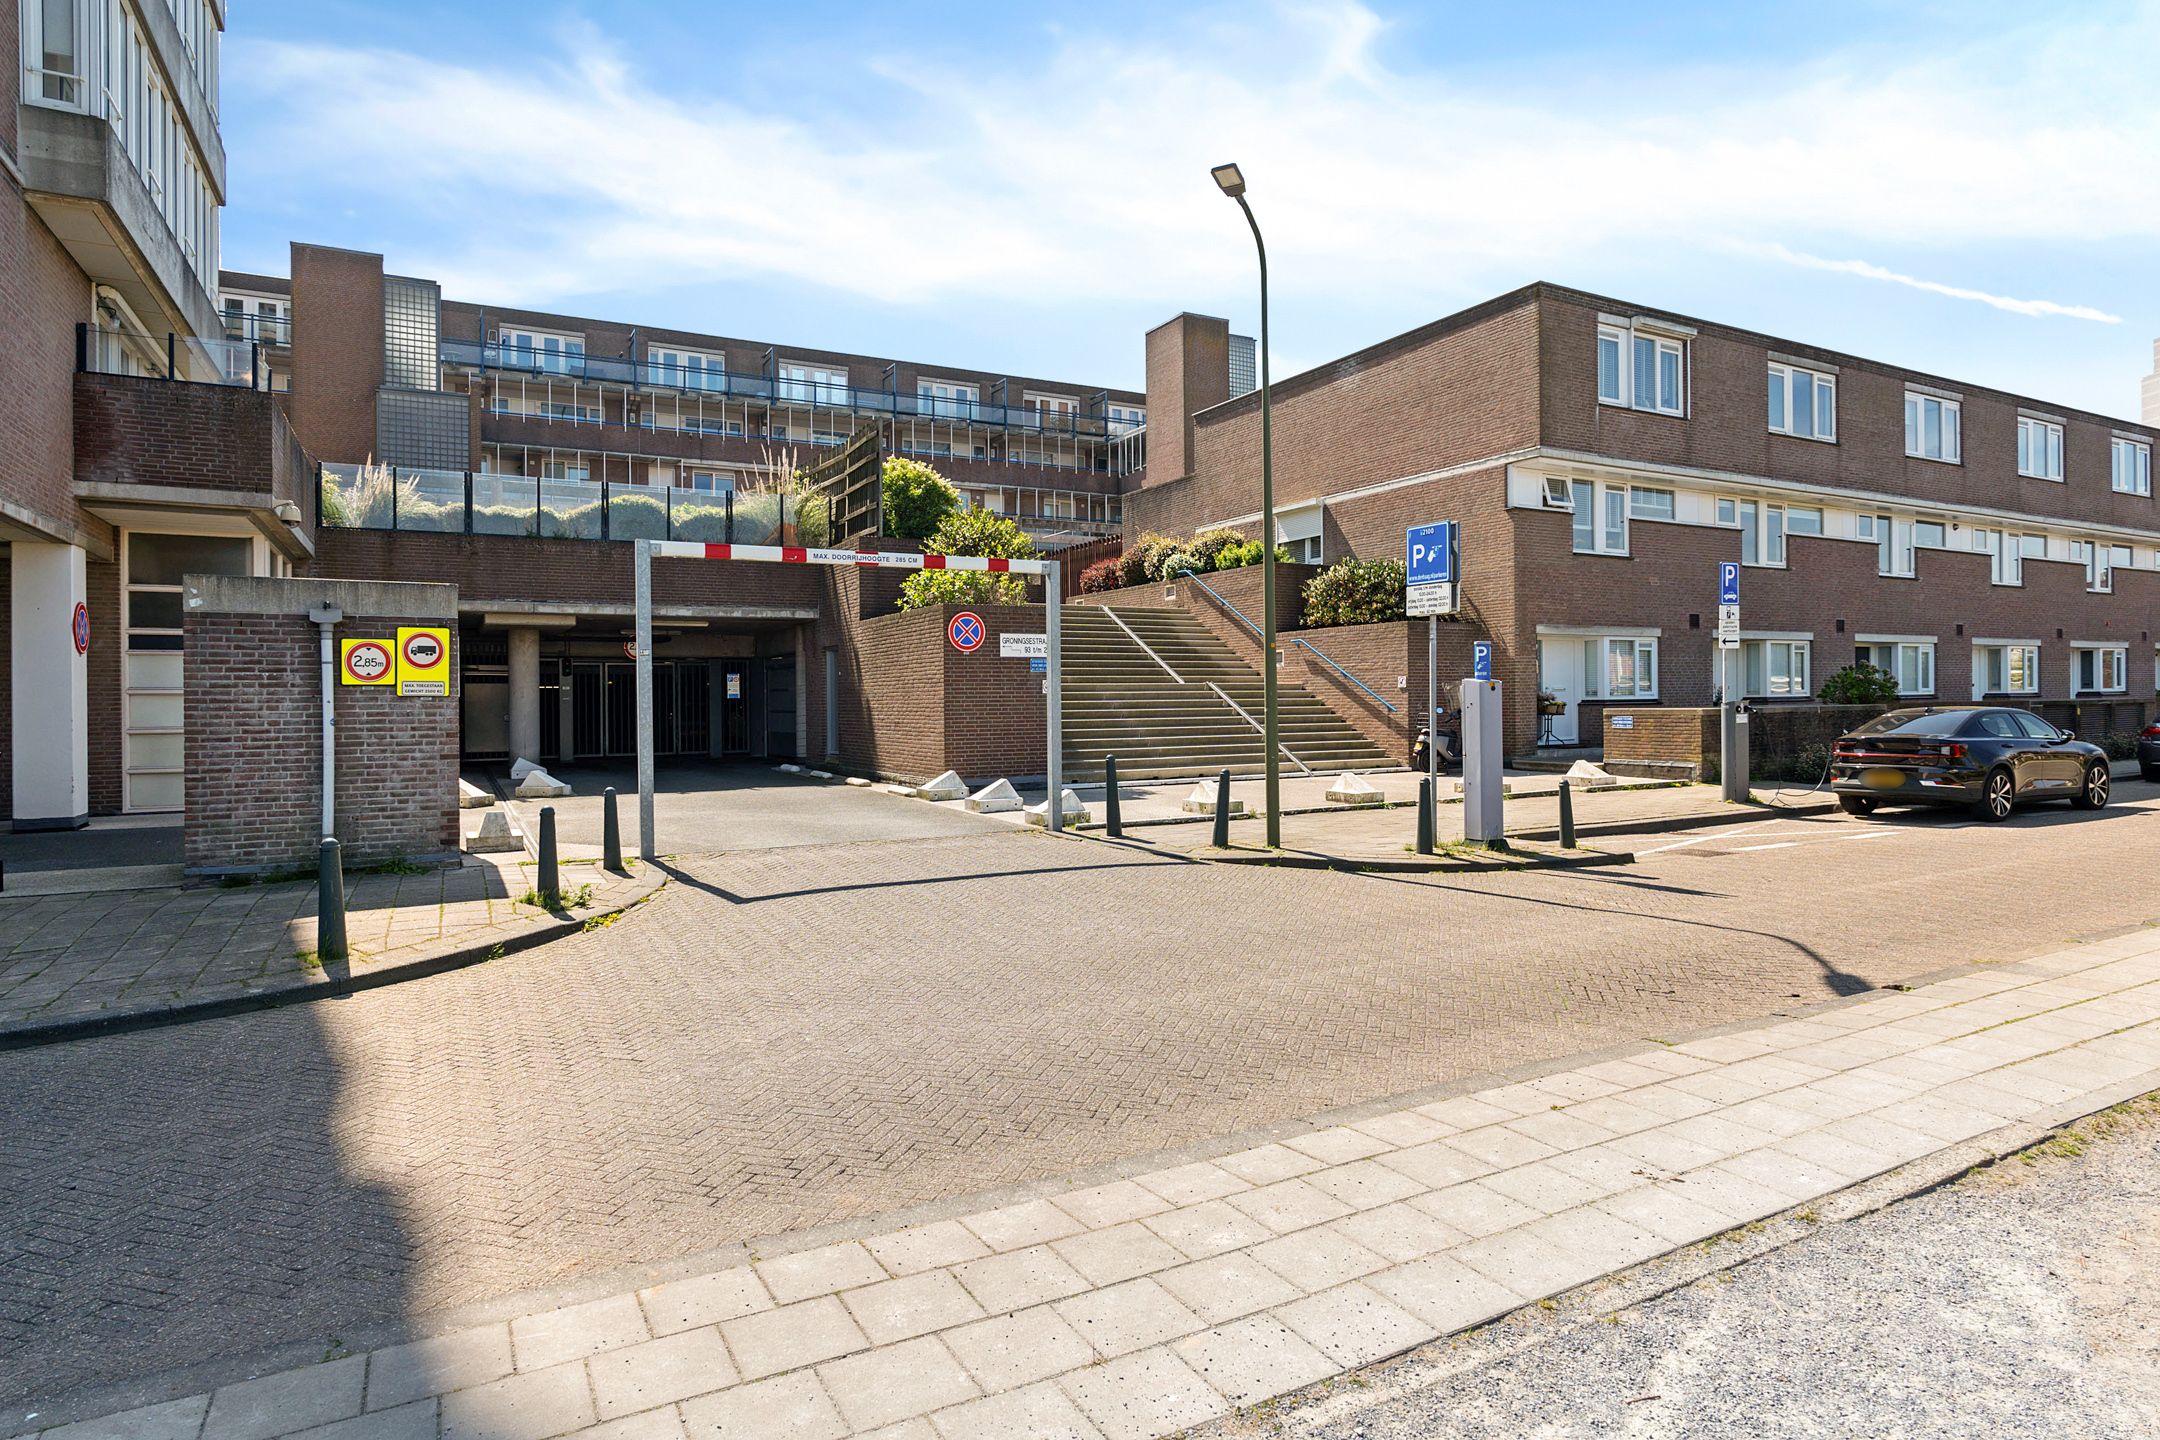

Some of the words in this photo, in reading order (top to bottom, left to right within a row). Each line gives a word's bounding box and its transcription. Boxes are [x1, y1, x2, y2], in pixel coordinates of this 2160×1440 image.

[831, 554, 890, 562] DOORRIJHOOGTE
[1413, 544, 1425, 568] P
[1725, 566, 1735, 587] P
[1476, 646, 1487, 661] P
[353, 655, 384, 668] 2,85m
